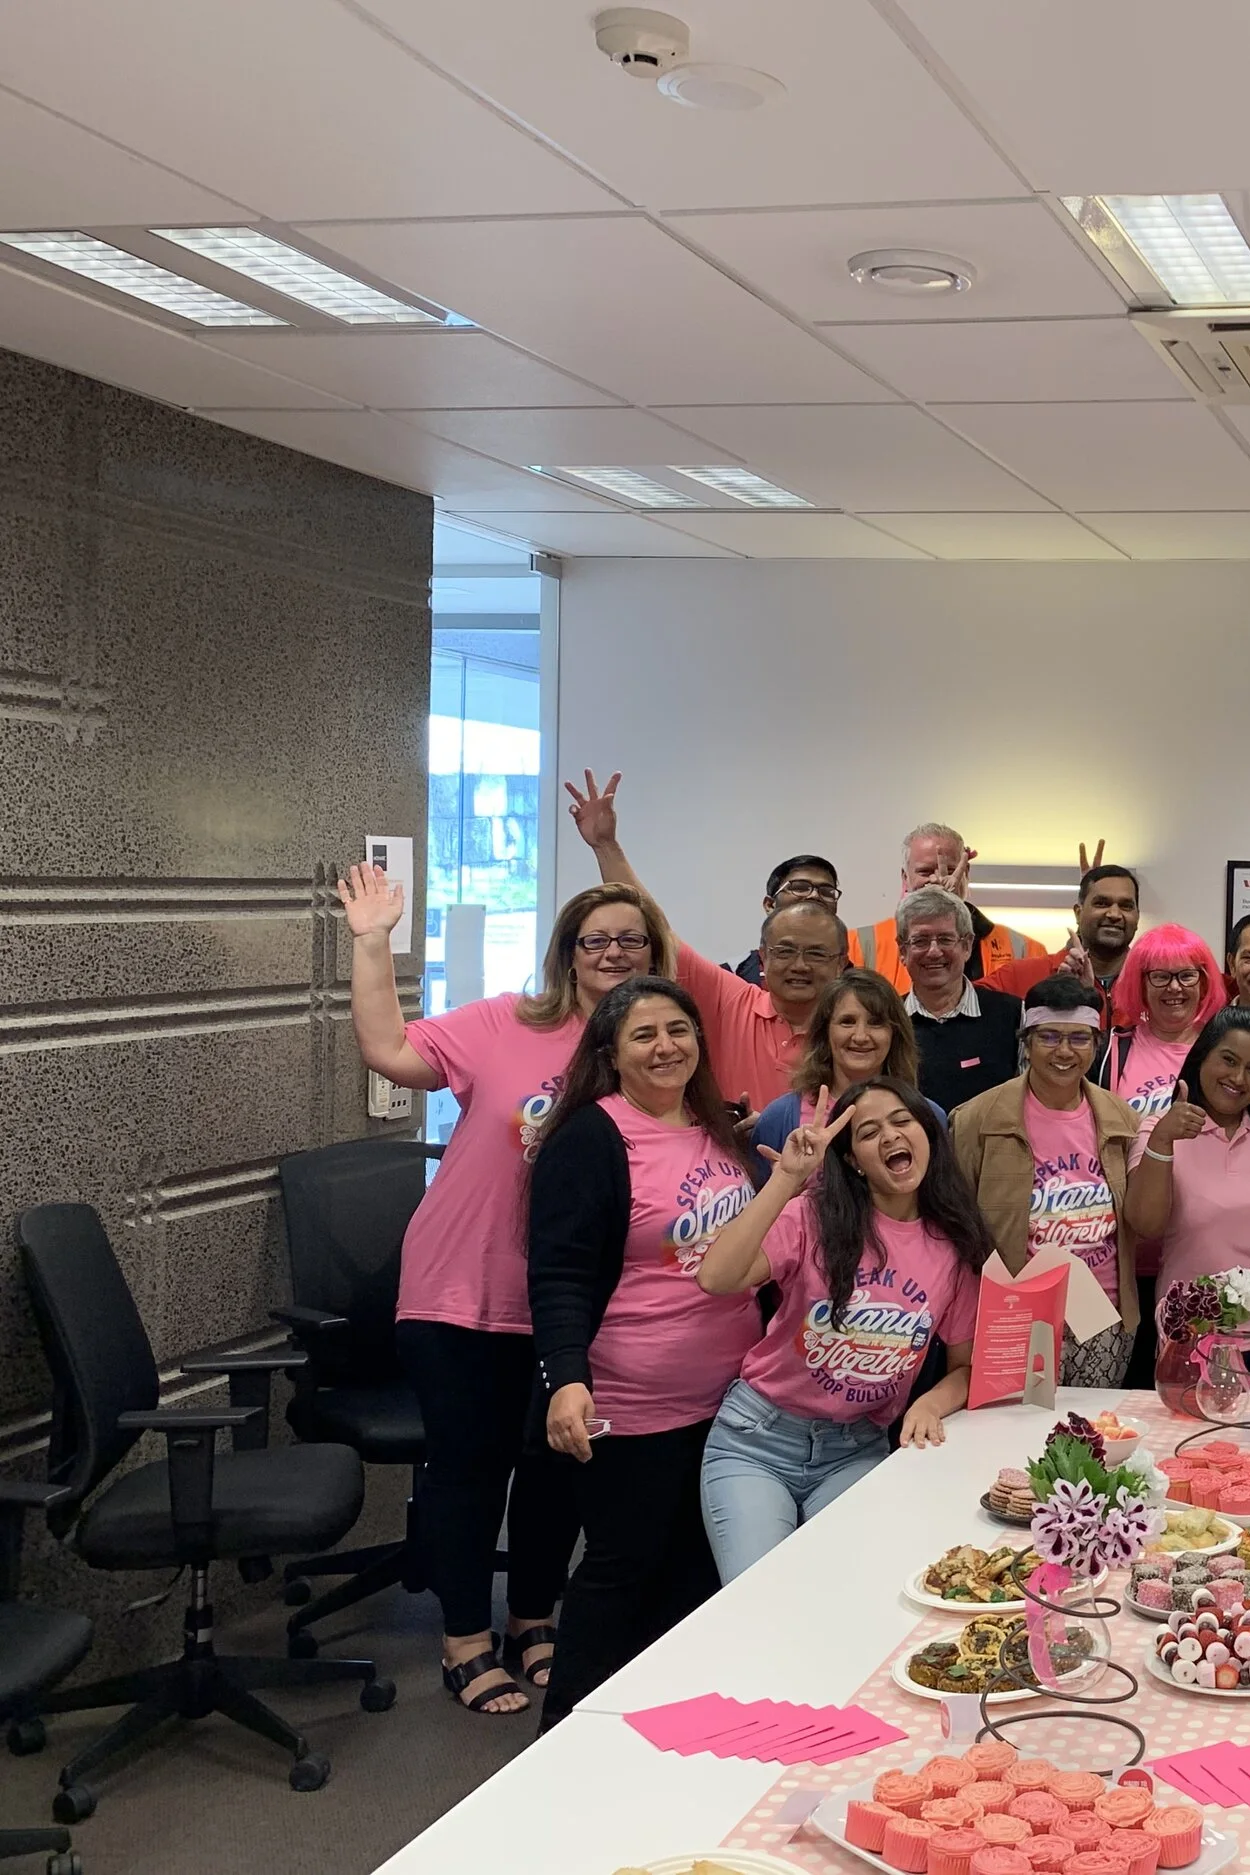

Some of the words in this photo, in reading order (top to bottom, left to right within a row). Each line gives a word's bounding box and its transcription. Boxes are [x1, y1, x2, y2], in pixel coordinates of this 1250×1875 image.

[1136, 1073, 1178, 1097] SPEA
[676, 1159, 716, 1210] SPEAK
[1031, 1216, 1117, 1252] Togethe
[855, 1267, 897, 1288] EAK
[902, 1278, 928, 1304] UP
[806, 1331, 918, 1382] Togethr
[811, 1368, 844, 1396] STOP
